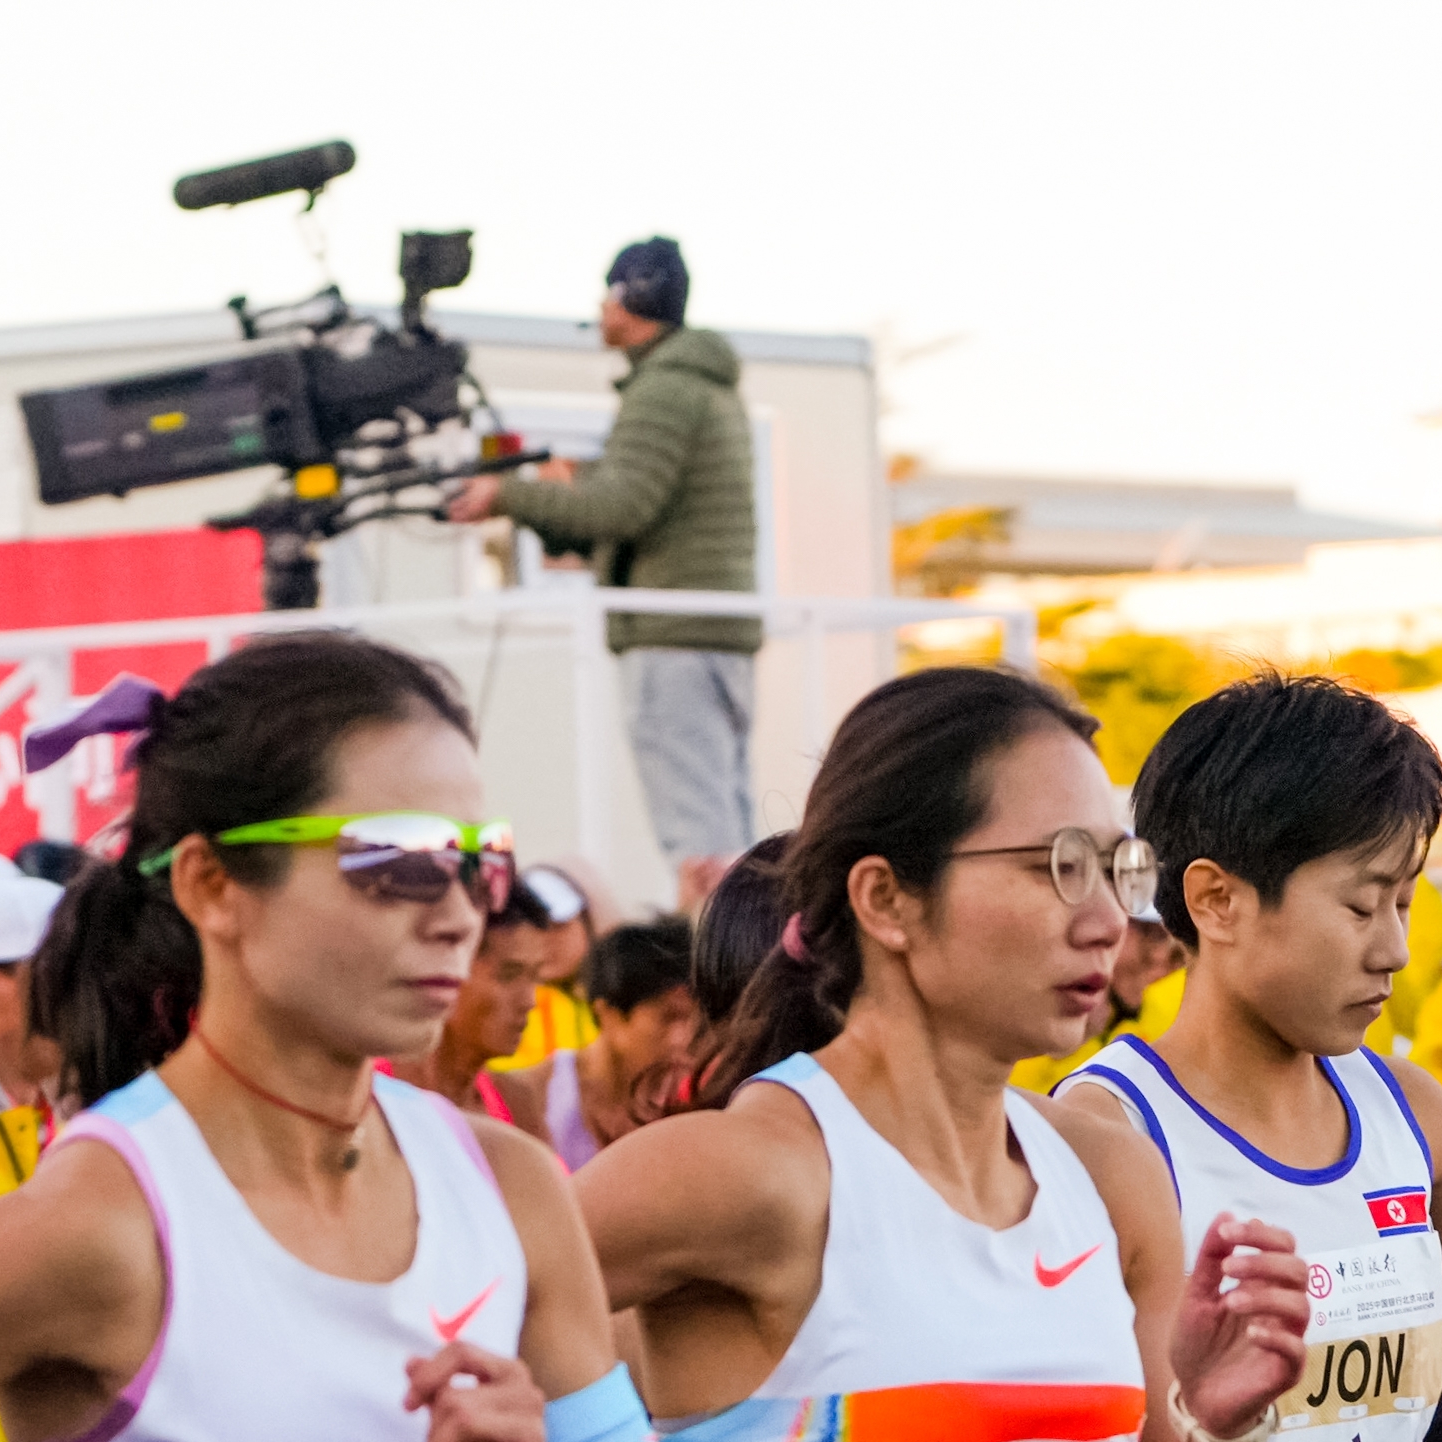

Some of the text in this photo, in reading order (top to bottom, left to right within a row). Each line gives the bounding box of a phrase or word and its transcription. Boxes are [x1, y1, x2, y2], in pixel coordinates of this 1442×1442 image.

[1335, 1253, 1398, 1281] 中国银行
[1306, 1333, 1406, 1408] JON
